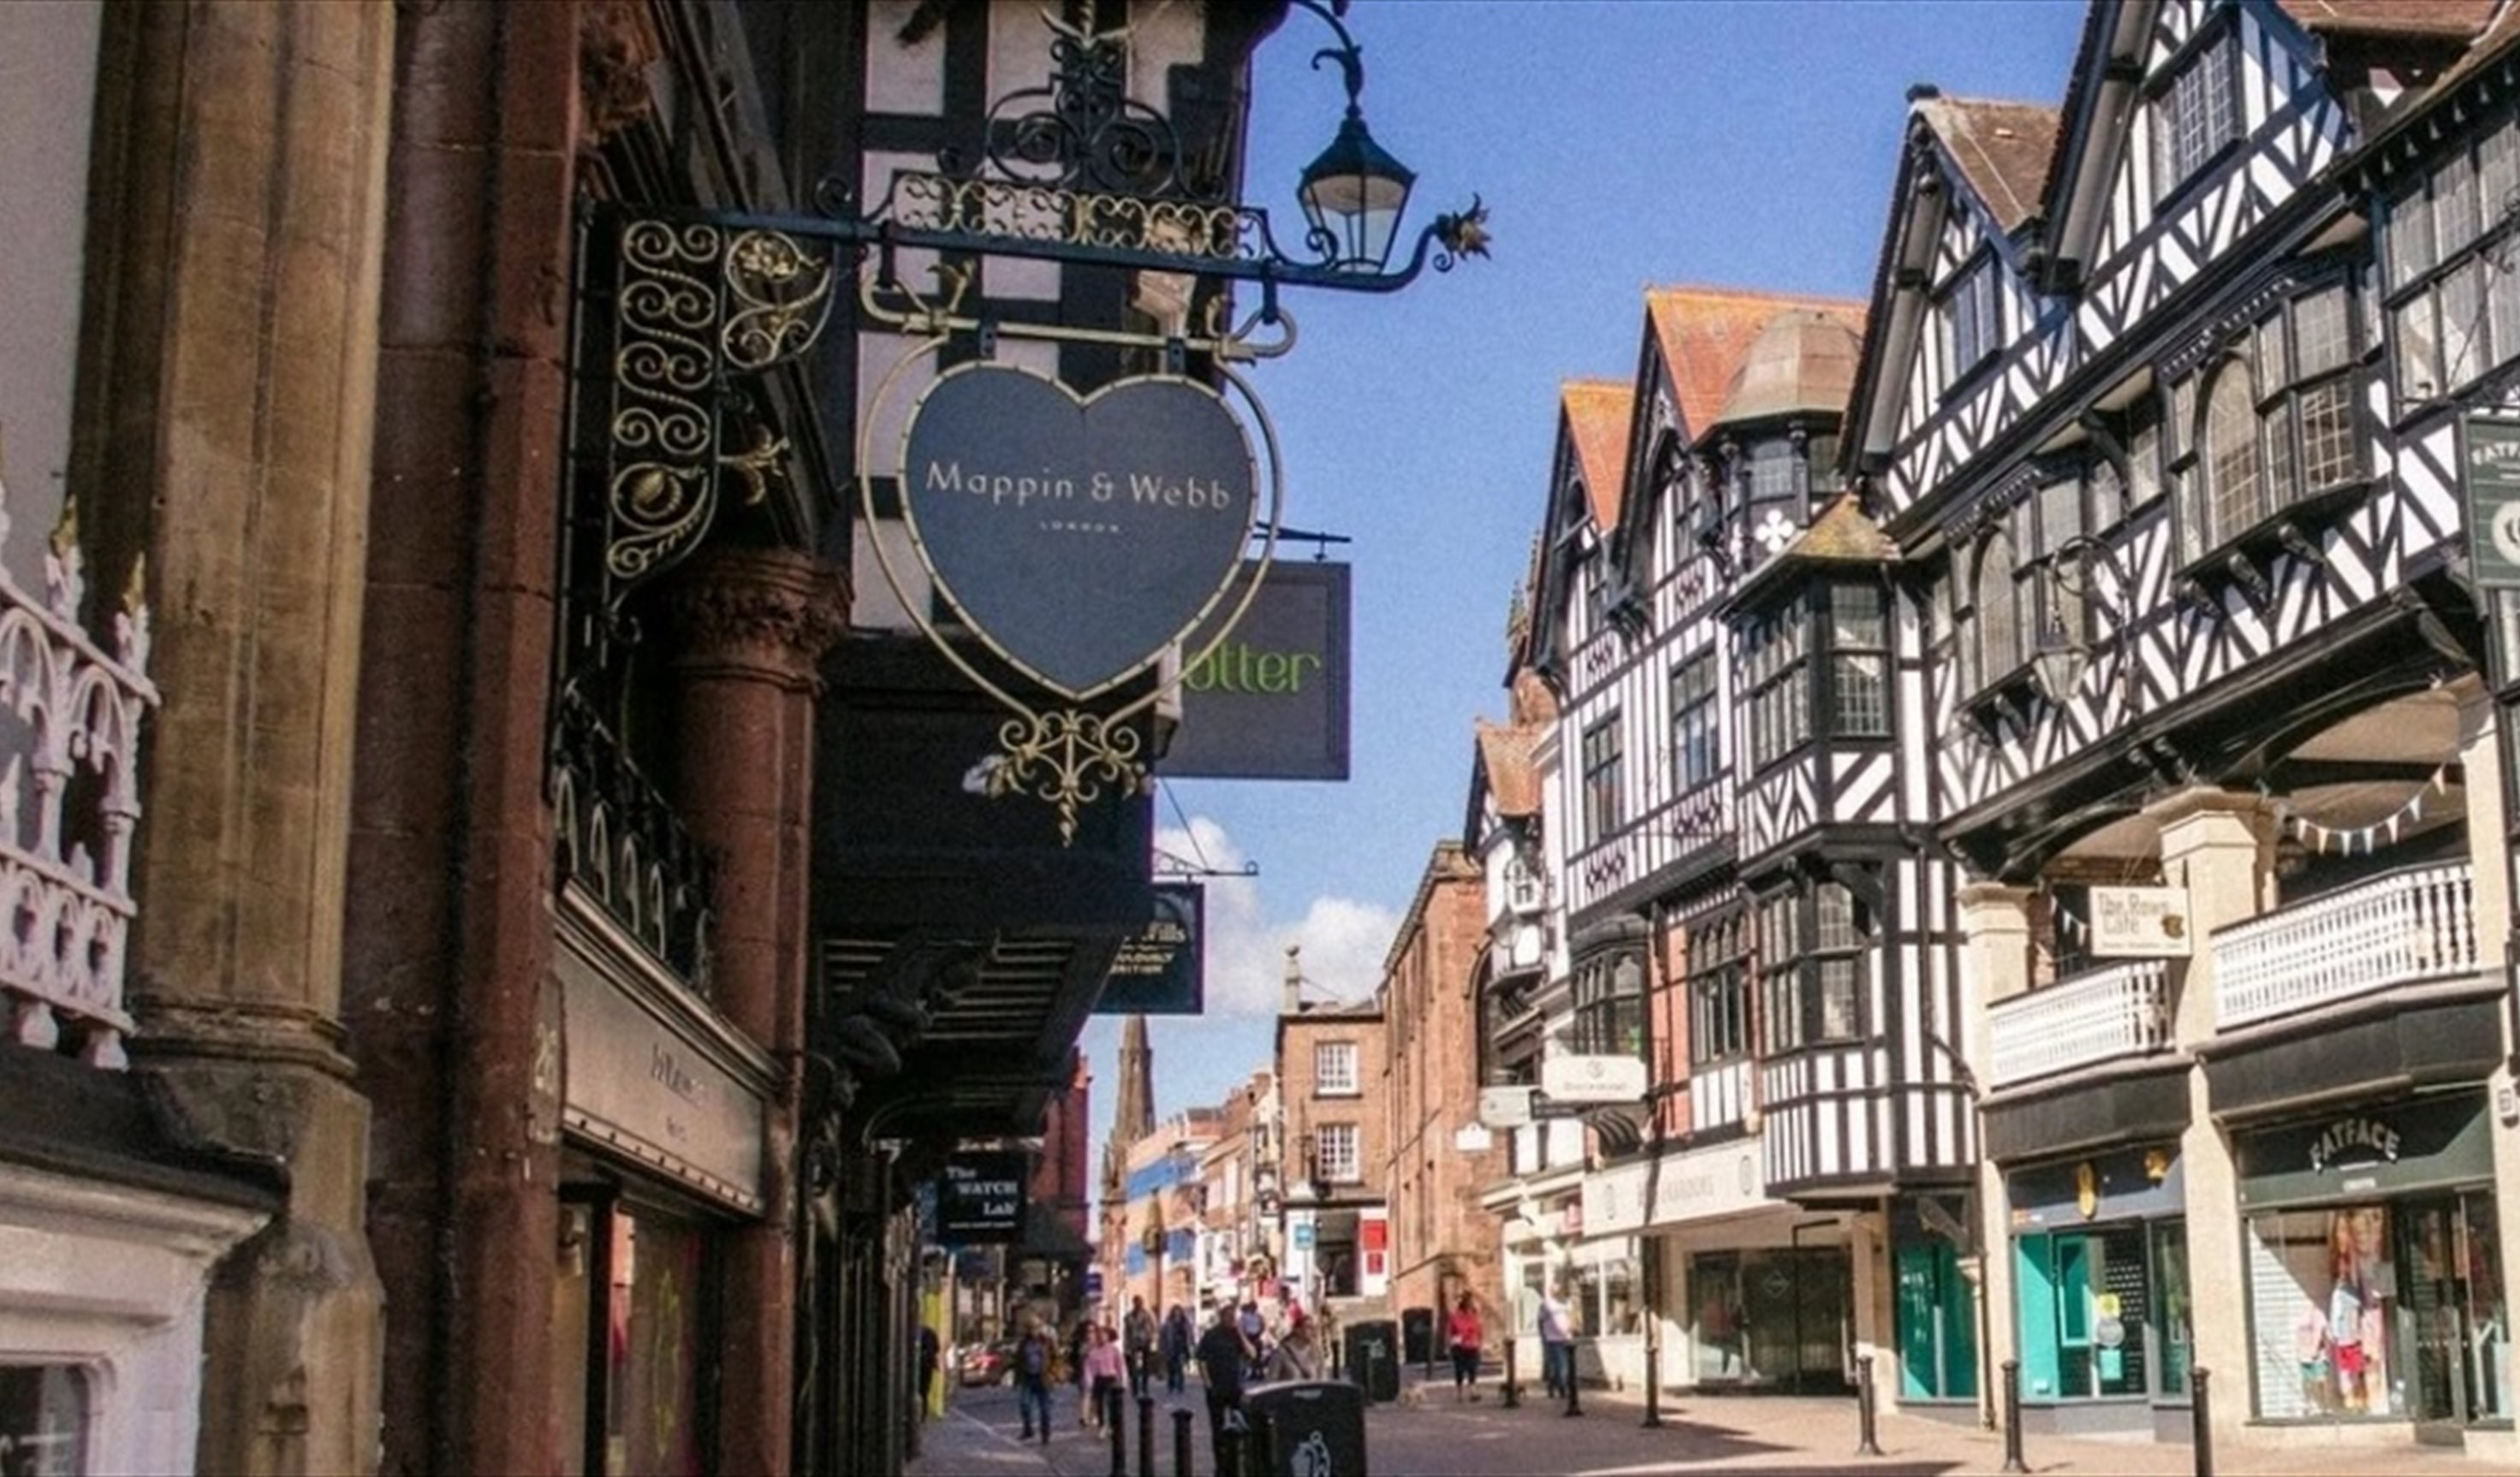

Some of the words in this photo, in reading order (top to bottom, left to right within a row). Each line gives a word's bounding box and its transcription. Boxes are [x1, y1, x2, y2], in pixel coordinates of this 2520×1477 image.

[925, 460, 1073, 507] Mappin
[1091, 472, 1114, 502] &
[1129, 472, 1231, 510] Webb
[1184, 642, 1322, 693] otter
[2309, 1118, 2401, 1171] FATFACE
[945, 1166, 977, 1180] The
[957, 1181, 1018, 1195] WATCH
